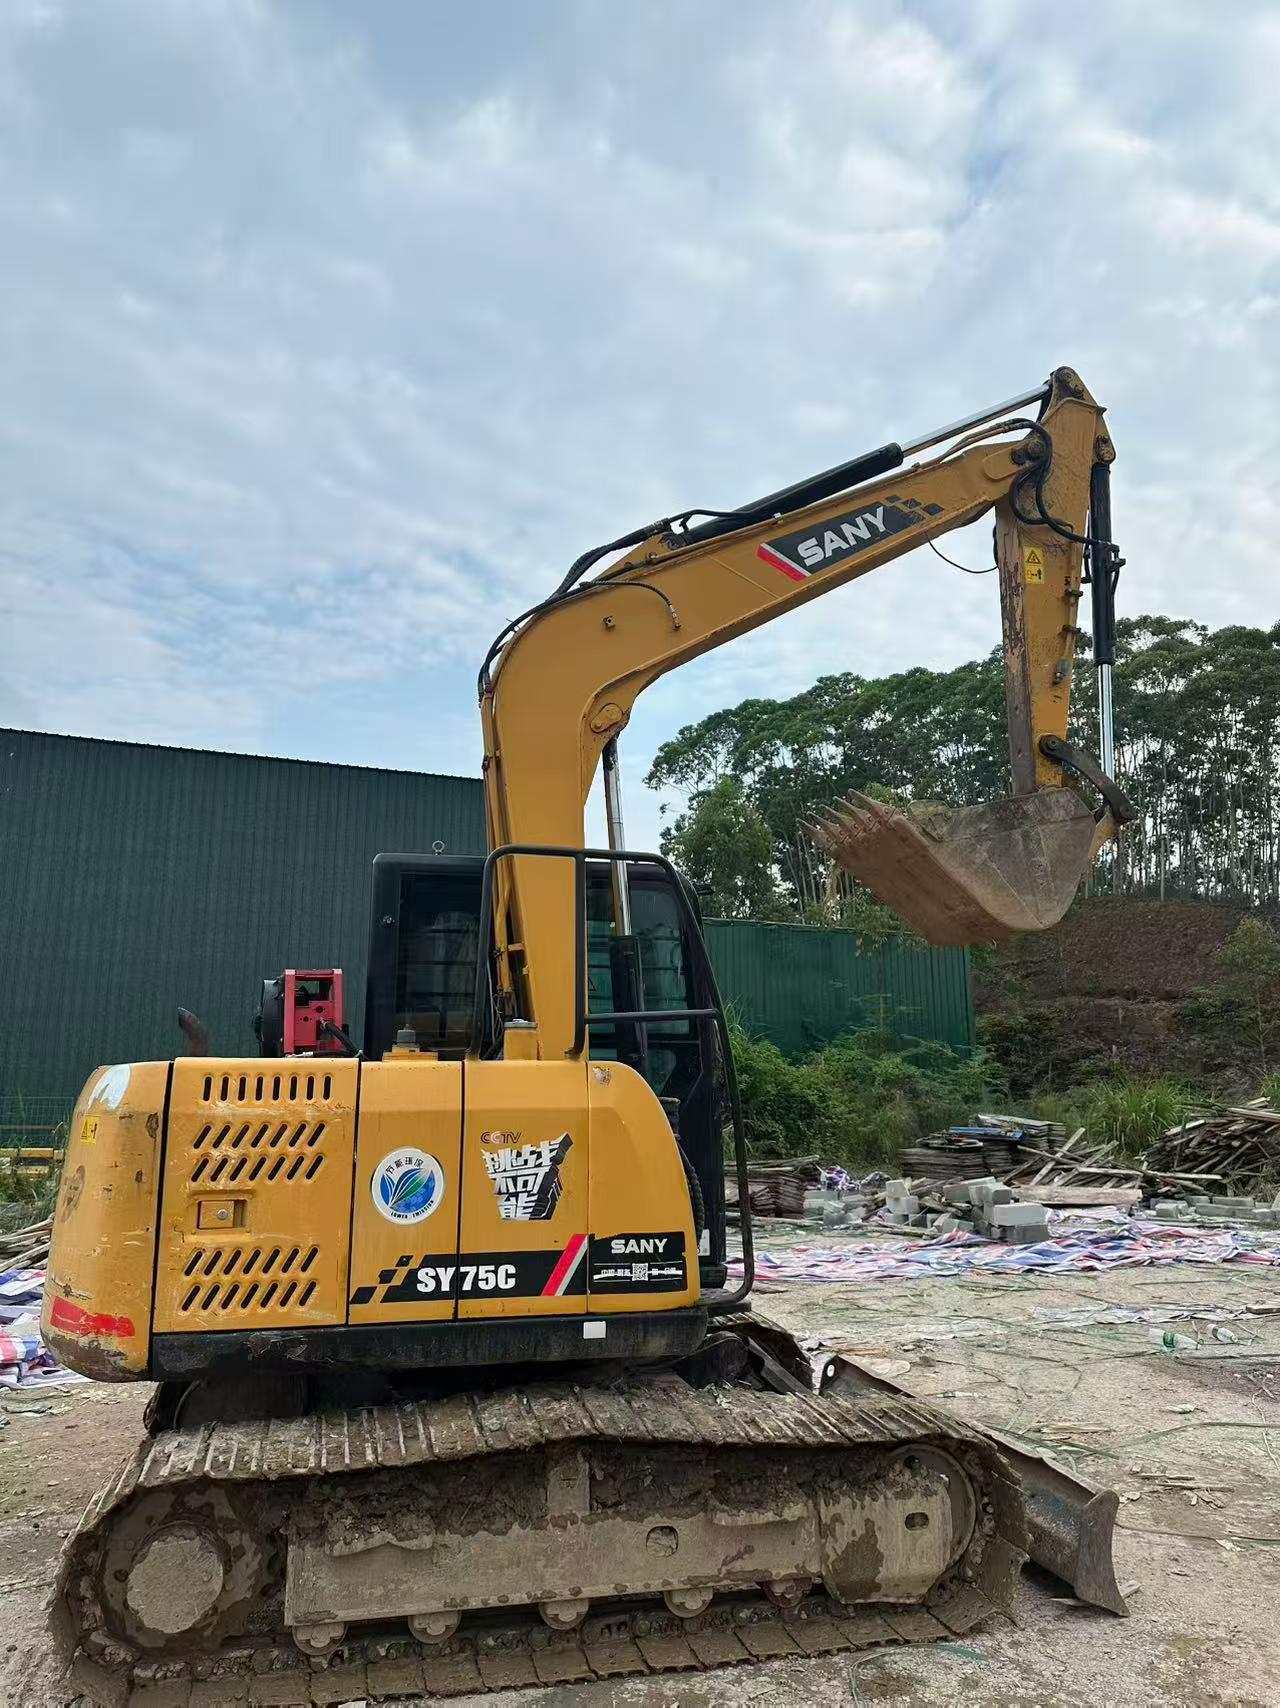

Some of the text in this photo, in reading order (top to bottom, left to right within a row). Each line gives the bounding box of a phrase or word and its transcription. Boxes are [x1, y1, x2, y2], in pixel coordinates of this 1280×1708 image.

[797, 506, 886, 567] SANY
[480, 1131, 522, 1144] CCTV
[611, 1238, 668, 1254] SANY
